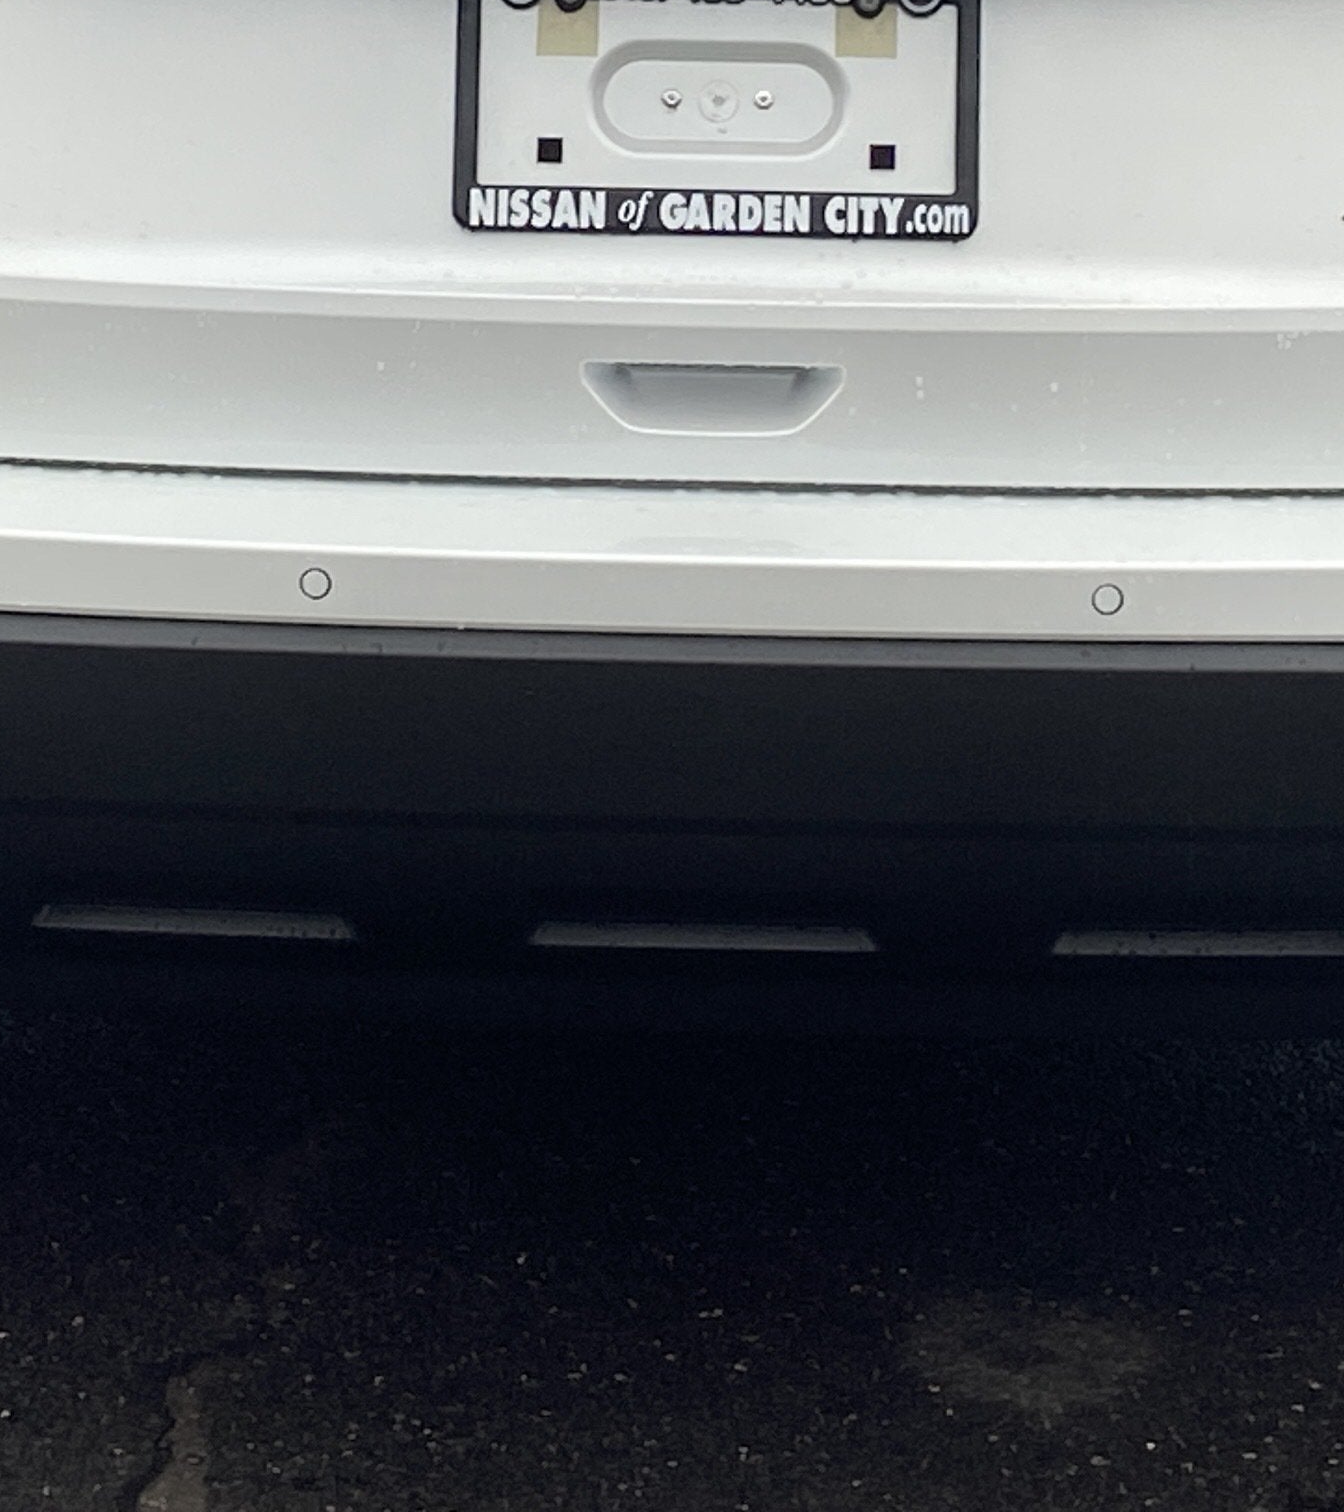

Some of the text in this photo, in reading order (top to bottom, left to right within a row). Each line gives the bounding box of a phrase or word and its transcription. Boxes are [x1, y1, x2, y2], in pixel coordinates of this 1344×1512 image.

[468, 189, 971, 235] NISSAN of GARDEN CITY.com
